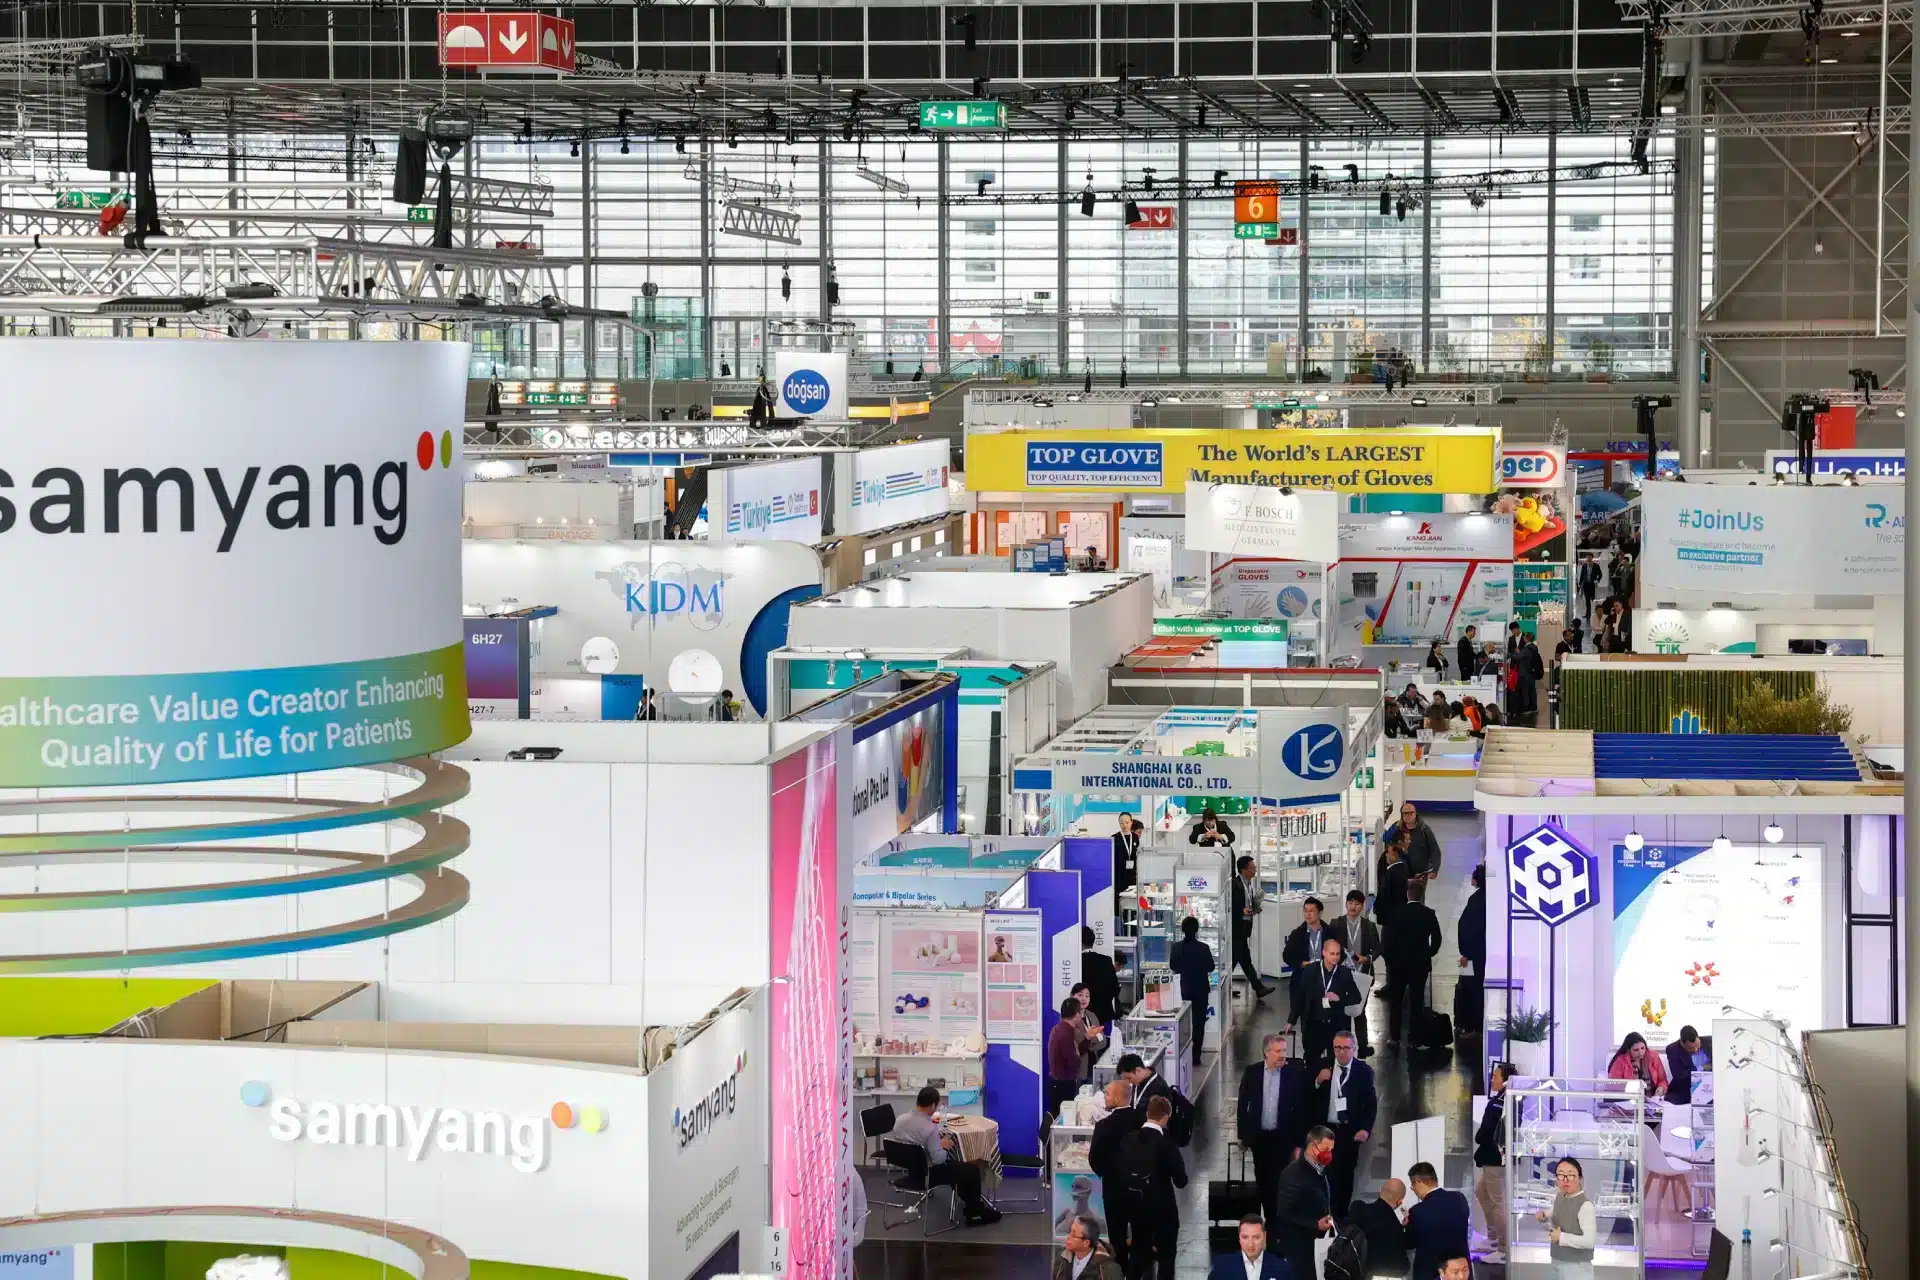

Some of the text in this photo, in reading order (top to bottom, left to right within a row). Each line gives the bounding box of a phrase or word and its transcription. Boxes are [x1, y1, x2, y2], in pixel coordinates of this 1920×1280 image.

[1248, 194, 1264, 219] 6
[787, 378, 826, 404] doğsan
[1030, 443, 1425, 465] TOP GLOVE The World's LARGEST
[1031, 473, 1047, 481] TOP
[1048, 473, 1089, 482] QUALITY,
[1108, 474, 1159, 482] EFFICIENCY
[1191, 468, 1433, 487] Manufacturer of Gloves
[862, 479, 886, 507] Türkiye
[742, 500, 772, 532] Türkiye
[1255, 506, 1294, 520] BOSCH
[1678, 508, 1764, 531] #JoinUs
[548, 531, 594, 540] BANDAGE
[1241, 535, 1281, 547] GERMANY
[1688, 551, 1725, 560] exclusive
[1726, 554, 1760, 562] partner
[1158, 624, 1176, 632] chat
[1234, 625, 1251, 633] TOP
[1251, 625, 1281, 633] GLOVE
[472, 633, 503, 645] 6H27
[0, 672, 444, 727] althcare Value Creator Enhancing
[40, 716, 412, 770] Quality of Life for Patients
[1111, 762, 1202, 775] SHANGHAI K&G
[869, 777, 879, 807] Pte
[879, 767, 889, 802] Ltd
[1081, 775, 1232, 790] INTERNATIONAL CO., LTD.
[885, 890, 891, 899] &
[891, 890, 916, 901] Bipolar
[916, 891, 937, 902] Series
[1095, 920, 1104, 946] 6H16
[1062, 959, 1071, 986] 6H16
[680, 1072, 737, 1148] samyang
[270, 1097, 549, 1174] samyang
[708, 1196, 732, 1228] Experience
[773, 1231, 780, 1242] 6
[0, 1253, 47, 1266] myang
[773, 1247, 779, 1256] J
[769, 1261, 782, 1272] 16
